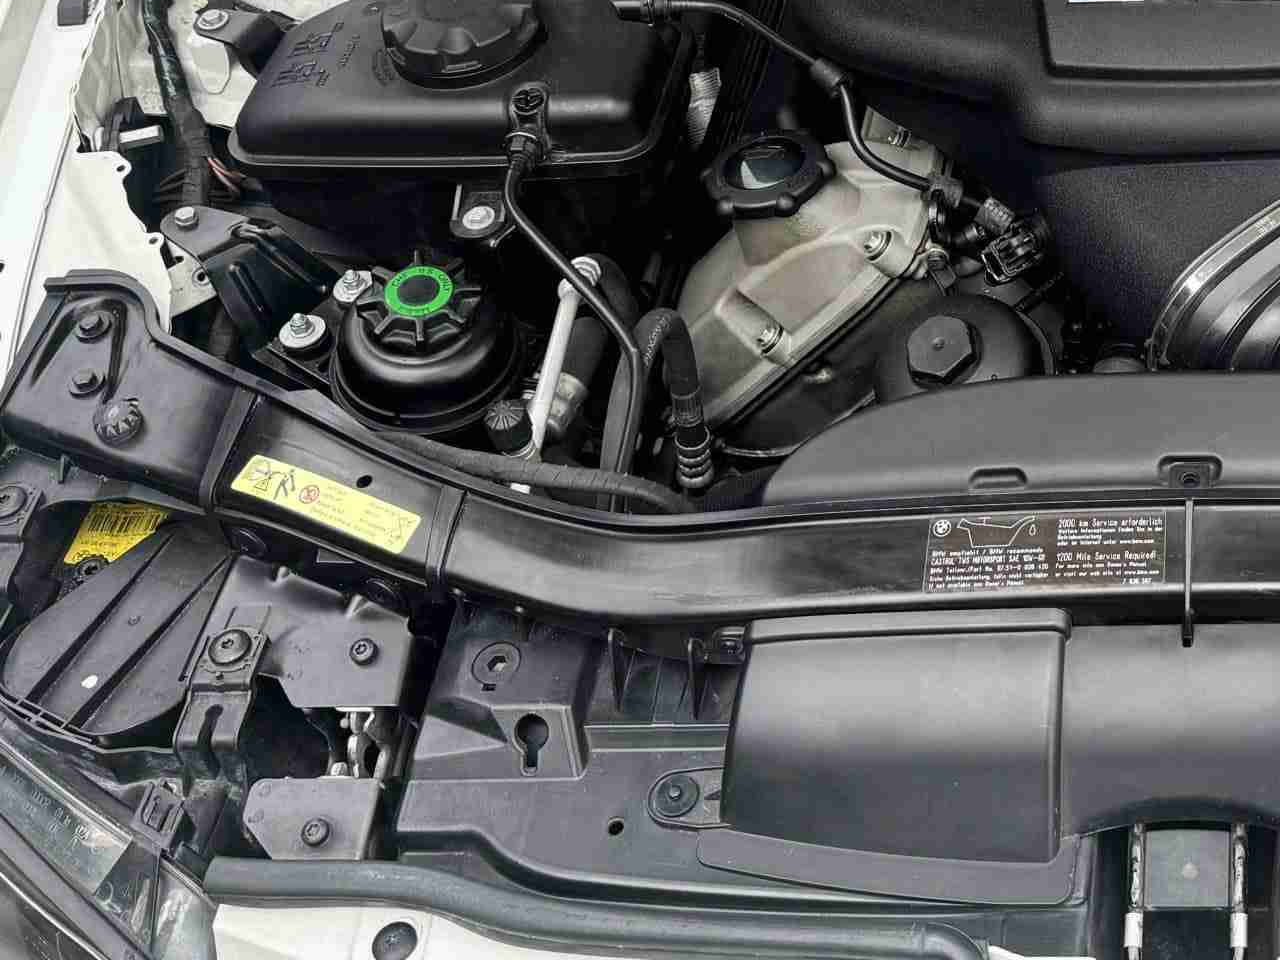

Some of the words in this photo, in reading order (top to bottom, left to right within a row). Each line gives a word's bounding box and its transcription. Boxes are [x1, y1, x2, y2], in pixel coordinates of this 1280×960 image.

[1058, 519, 1077, 528] 2000
[1091, 518, 1118, 527] Service
[1056, 551, 1073, 561] 1200
[1076, 551, 1091, 560] Mile
[1094, 551, 1121, 560] Service
